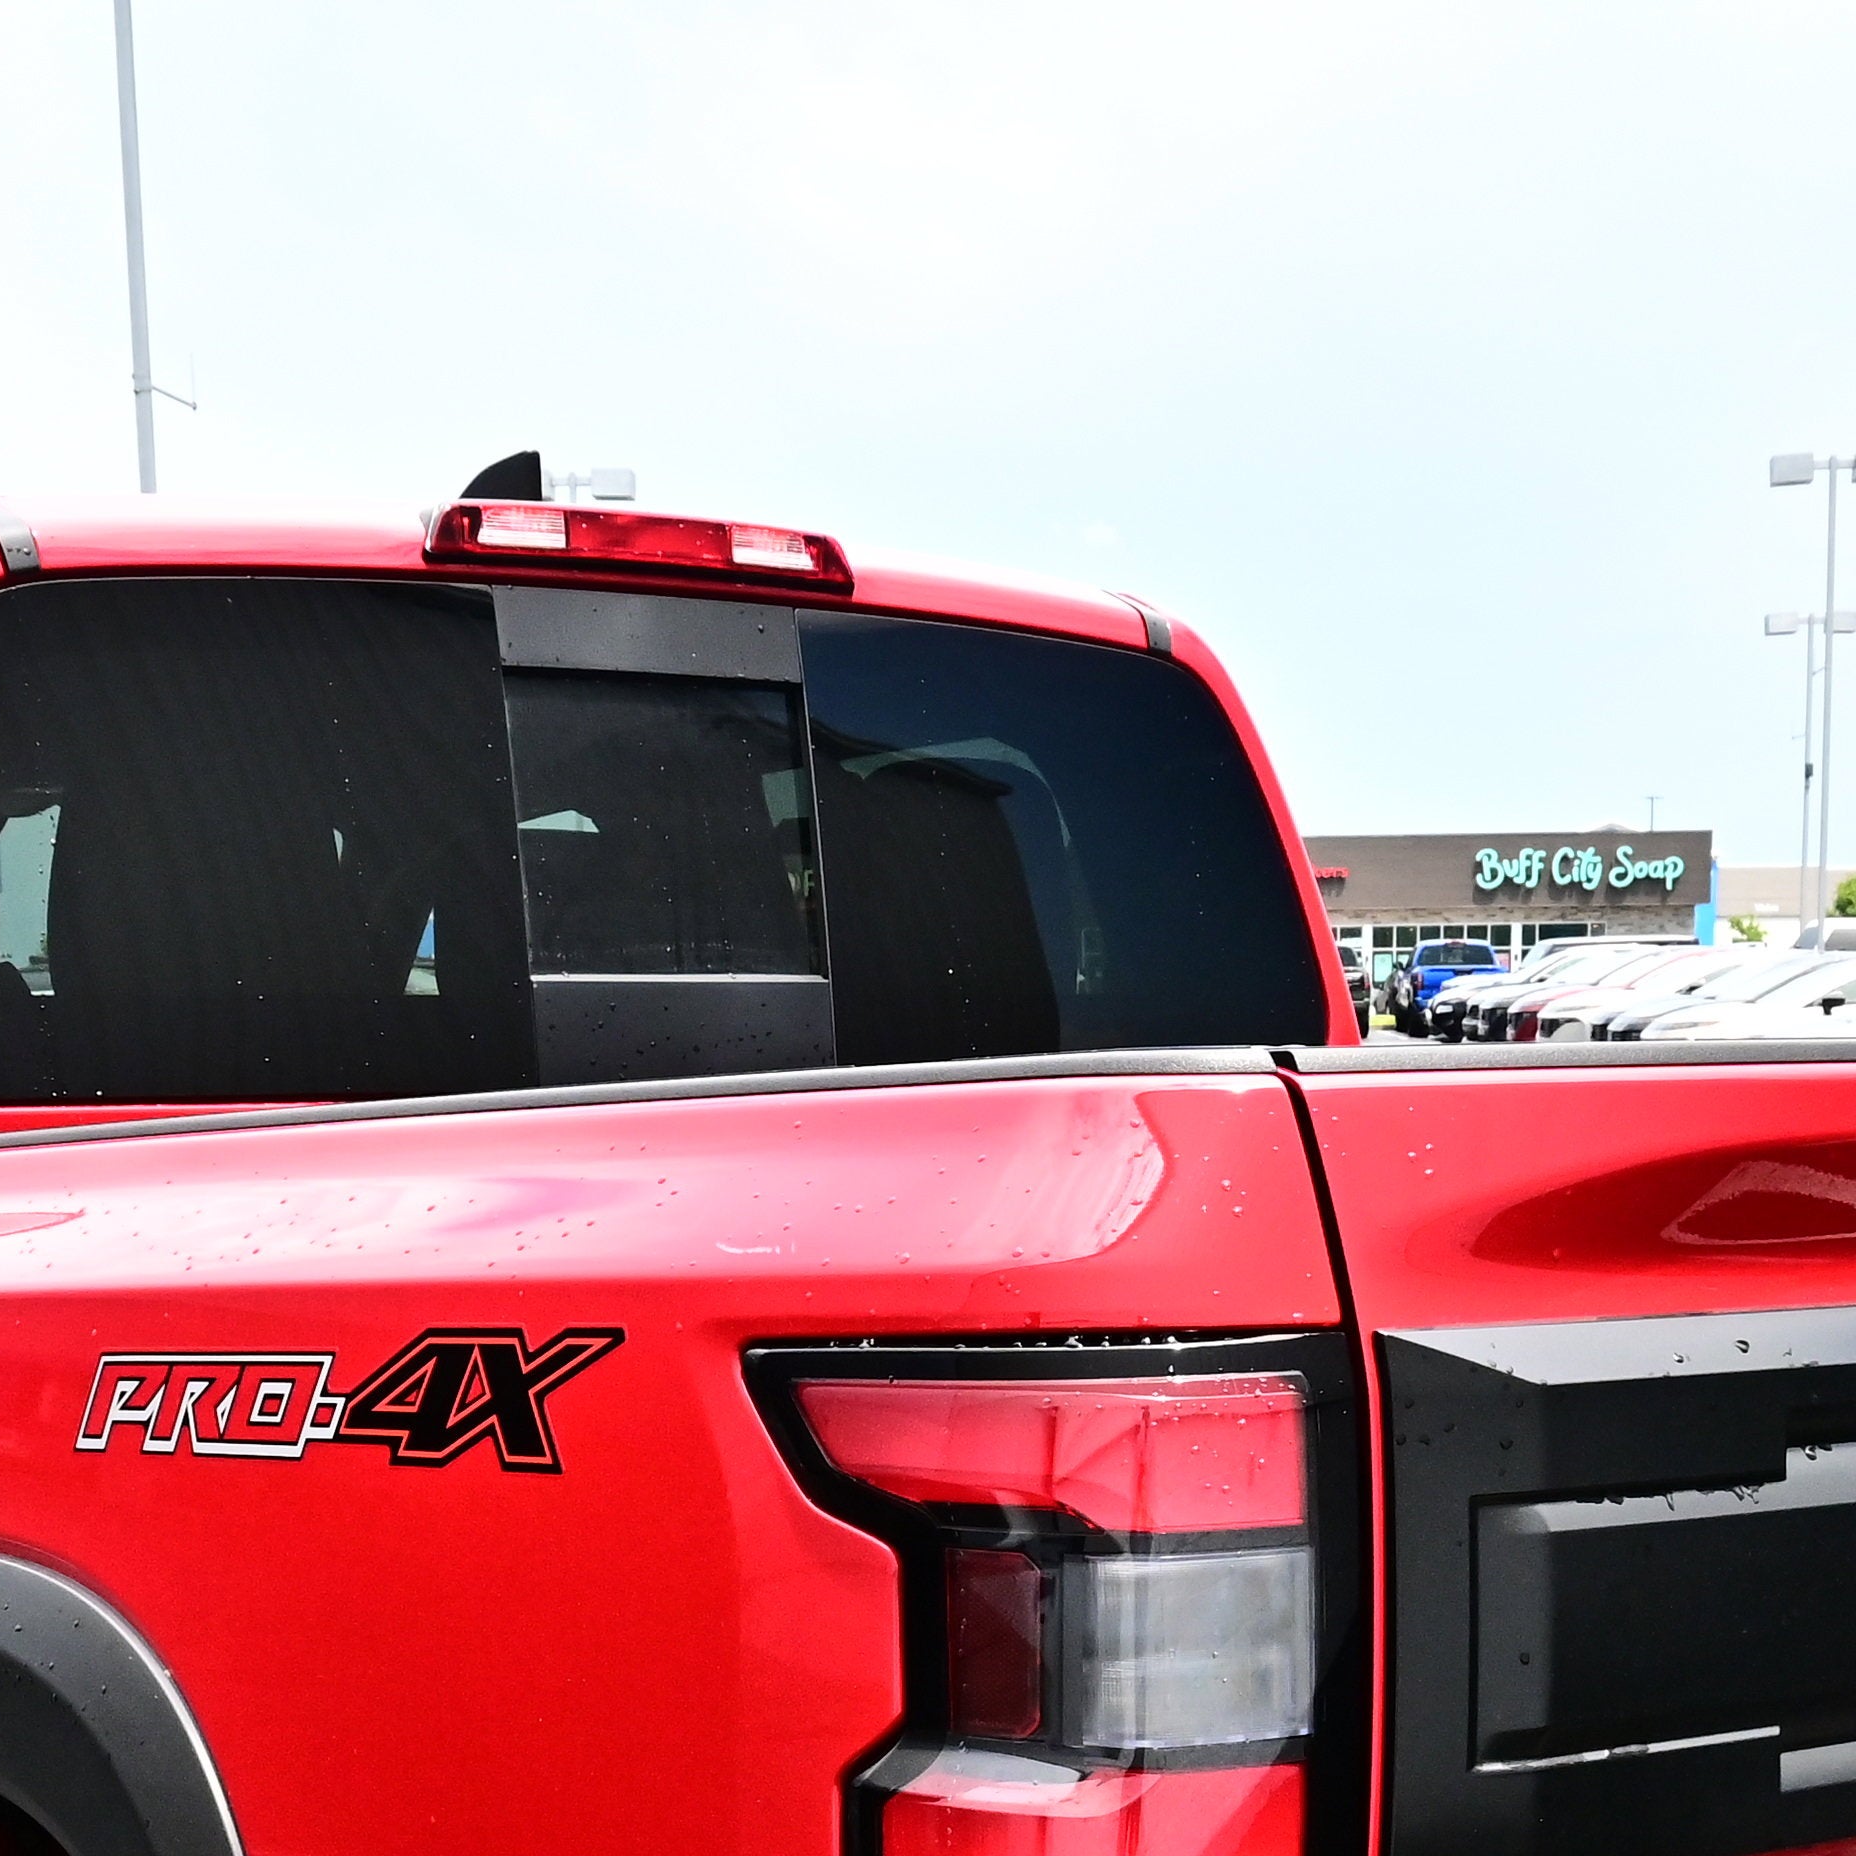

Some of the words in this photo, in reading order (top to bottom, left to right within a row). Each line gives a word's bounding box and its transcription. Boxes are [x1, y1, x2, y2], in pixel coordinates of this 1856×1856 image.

[1475, 846, 1546, 890] Buff
[1552, 846, 1603, 891] City
[1607, 845, 1685, 891] Soap
